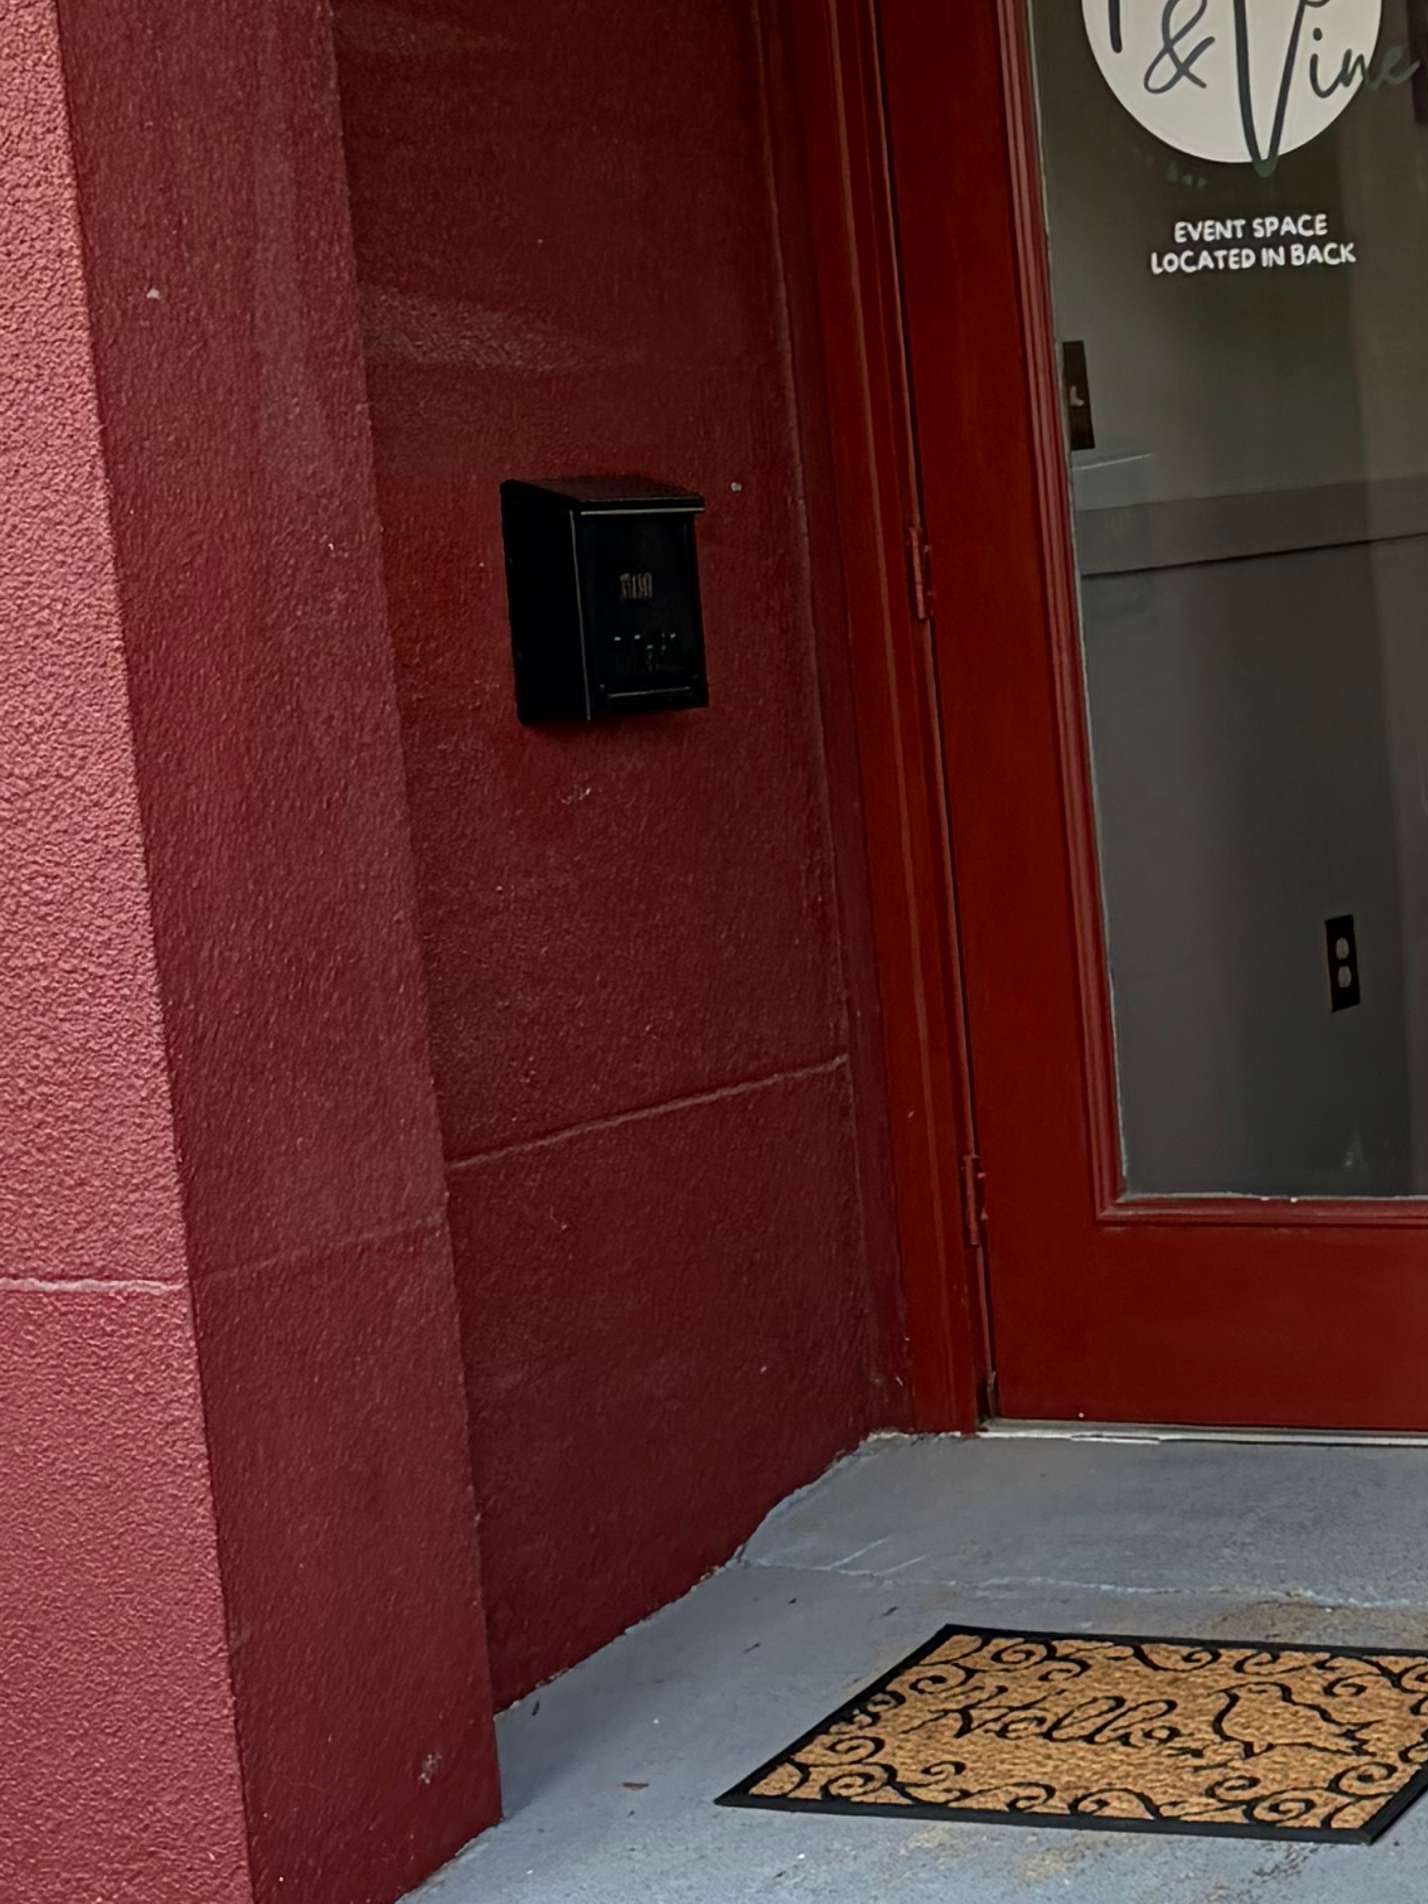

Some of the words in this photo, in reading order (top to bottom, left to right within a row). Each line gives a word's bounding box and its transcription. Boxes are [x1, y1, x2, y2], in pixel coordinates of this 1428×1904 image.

[1174, 218, 1246, 244] EVENT
[1252, 213, 1329, 239] SPACE
[1150, 247, 1256, 275] LOCATED
[1261, 245, 1285, 267] IN
[1290, 242, 1357, 267] BACK
[905, 1685, 1183, 1749] Hello
